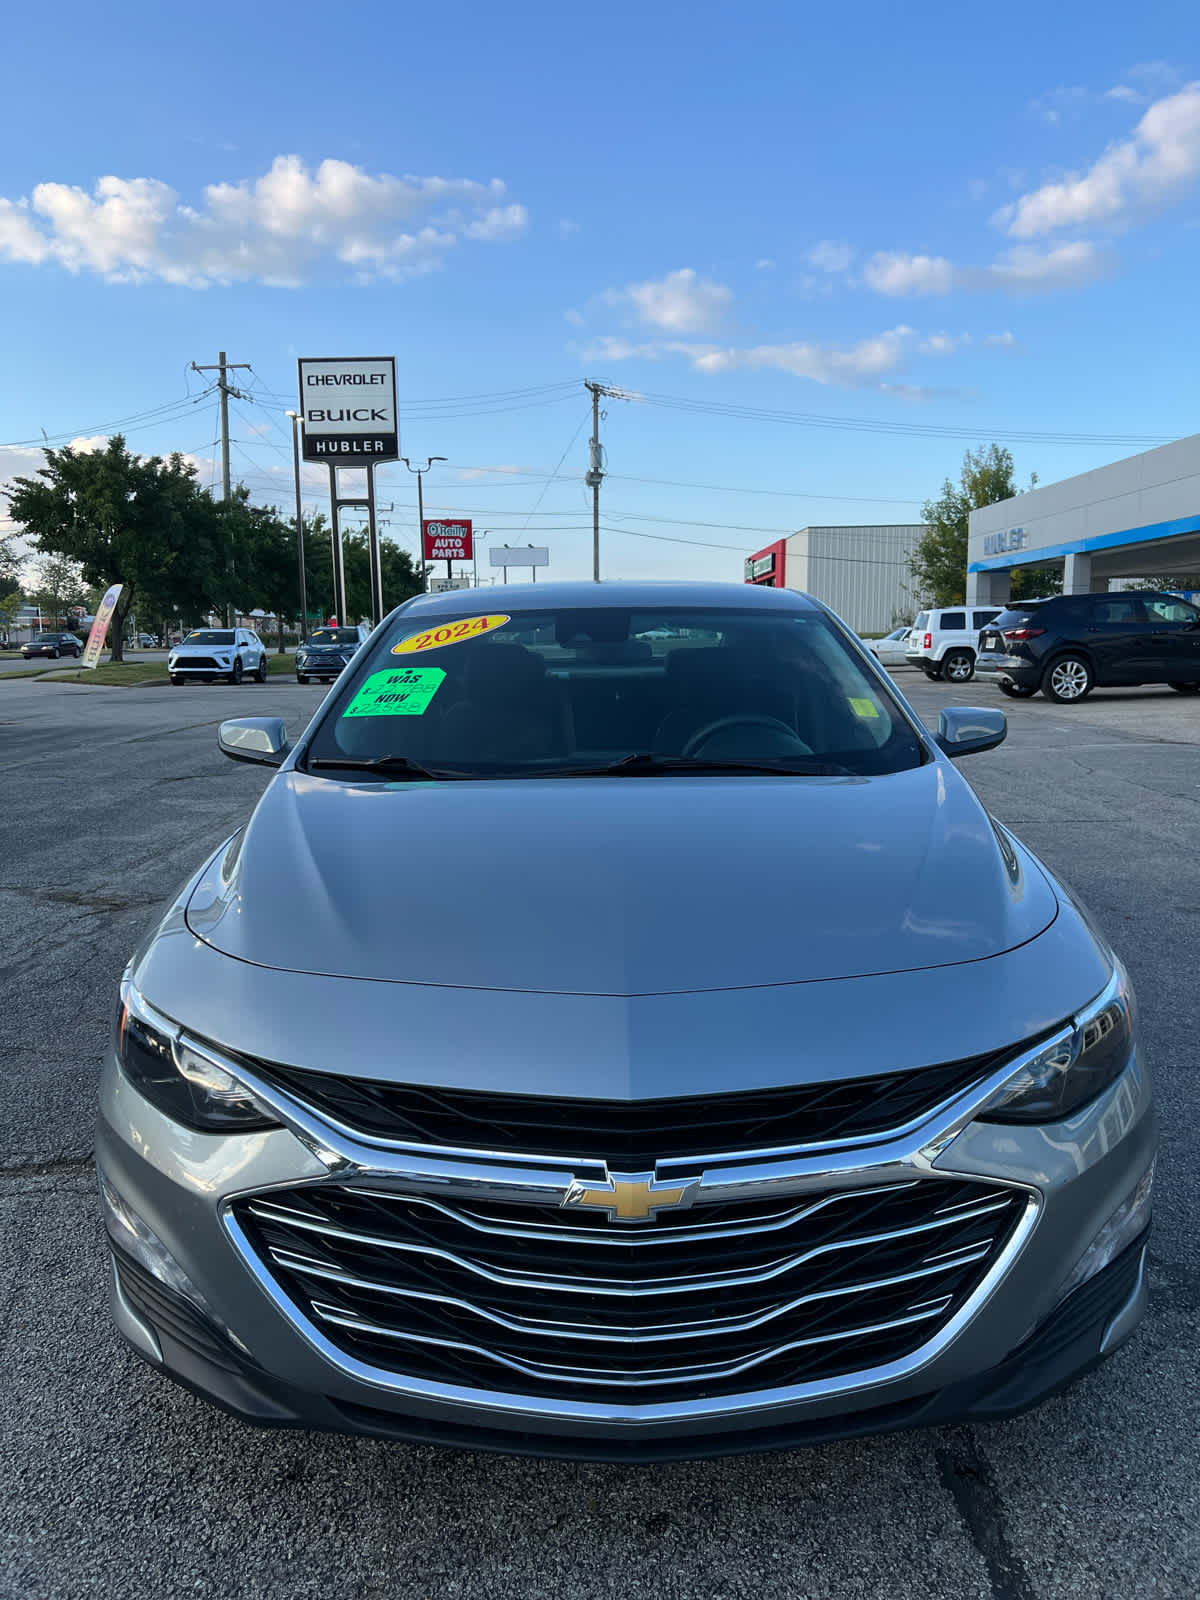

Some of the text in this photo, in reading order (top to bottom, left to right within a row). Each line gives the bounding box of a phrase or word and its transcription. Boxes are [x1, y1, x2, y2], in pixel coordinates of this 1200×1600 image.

[307, 373, 387, 386] CHEVROLET
[307, 408, 390, 422] BUICK
[316, 440, 384, 453] HUBLER
[427, 522, 468, 538] O'Reilly
[434, 539, 463, 548] AUTO
[432, 549, 465, 558] PARTS
[416, 617, 490, 650] 2024
[386, 674, 422, 684] WAS
[374, 693, 410, 704] NOW
